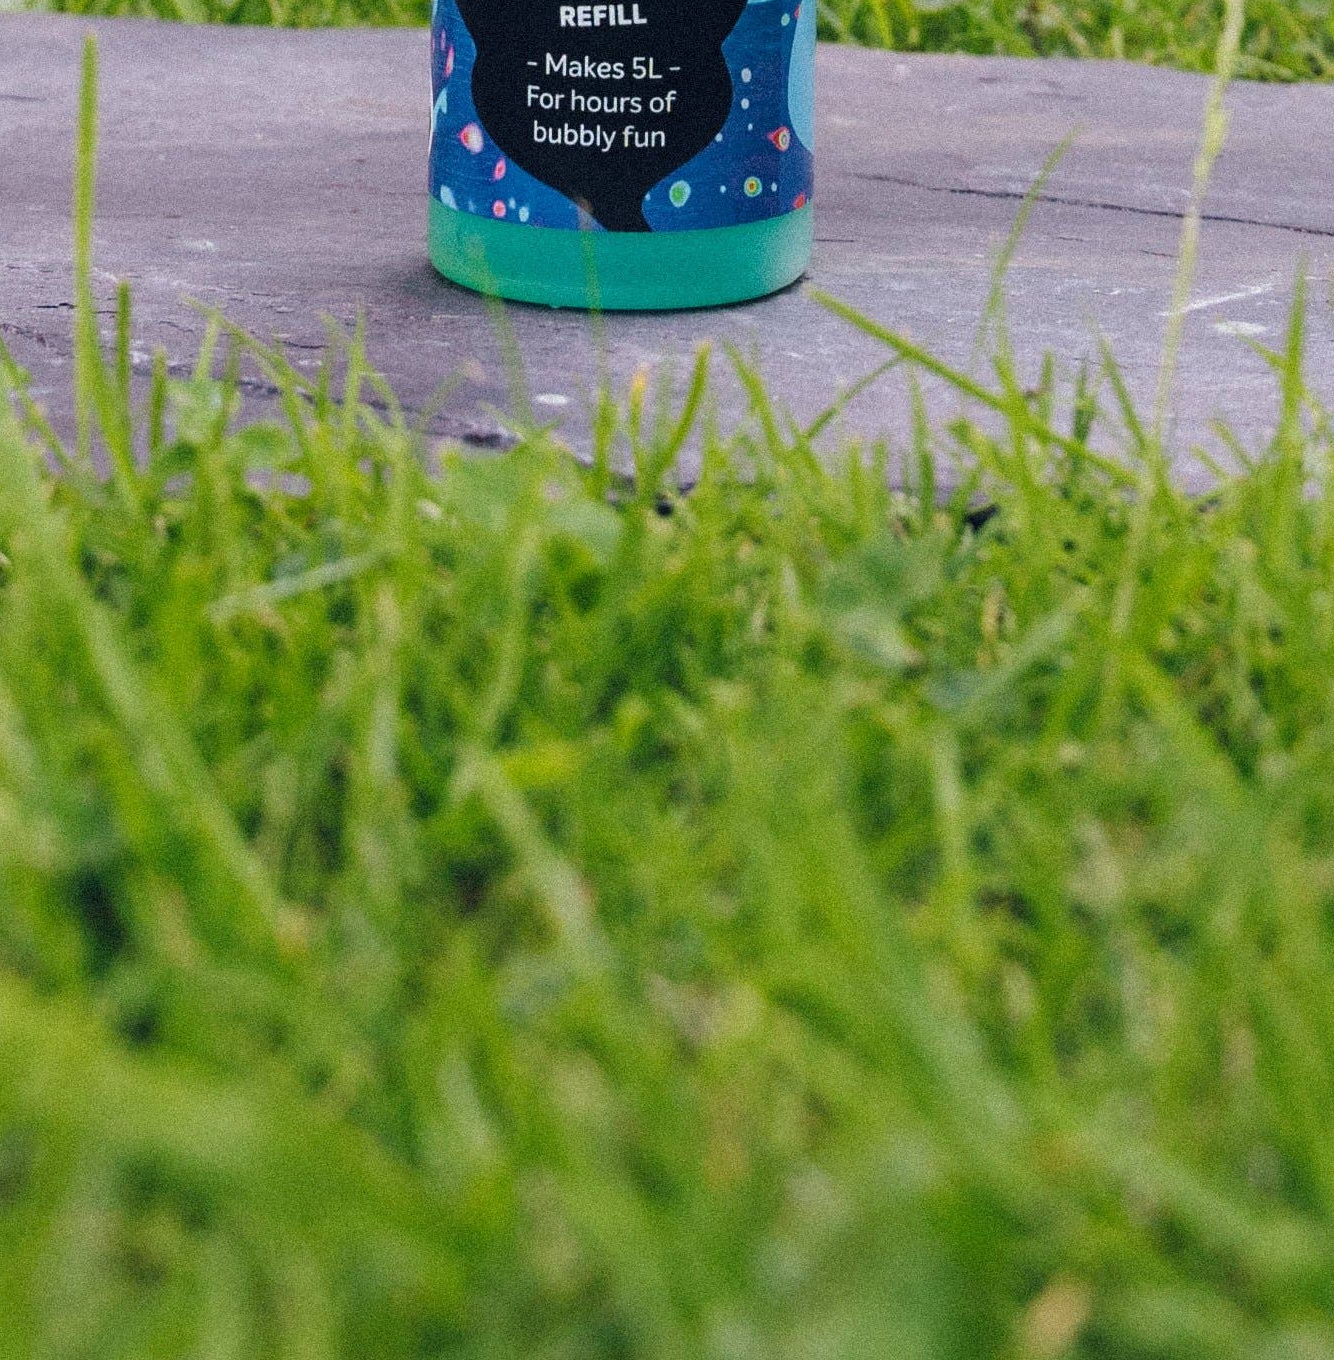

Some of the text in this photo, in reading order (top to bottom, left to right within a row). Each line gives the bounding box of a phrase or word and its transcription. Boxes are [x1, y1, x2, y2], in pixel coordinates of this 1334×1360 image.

[559, 3, 648, 27] REFILL
[545, 52, 625, 80] Makes
[632, 56, 663, 80] 5L
[526, 84, 677, 114] For hours of
[533, 119, 666, 153] bubbly fun
